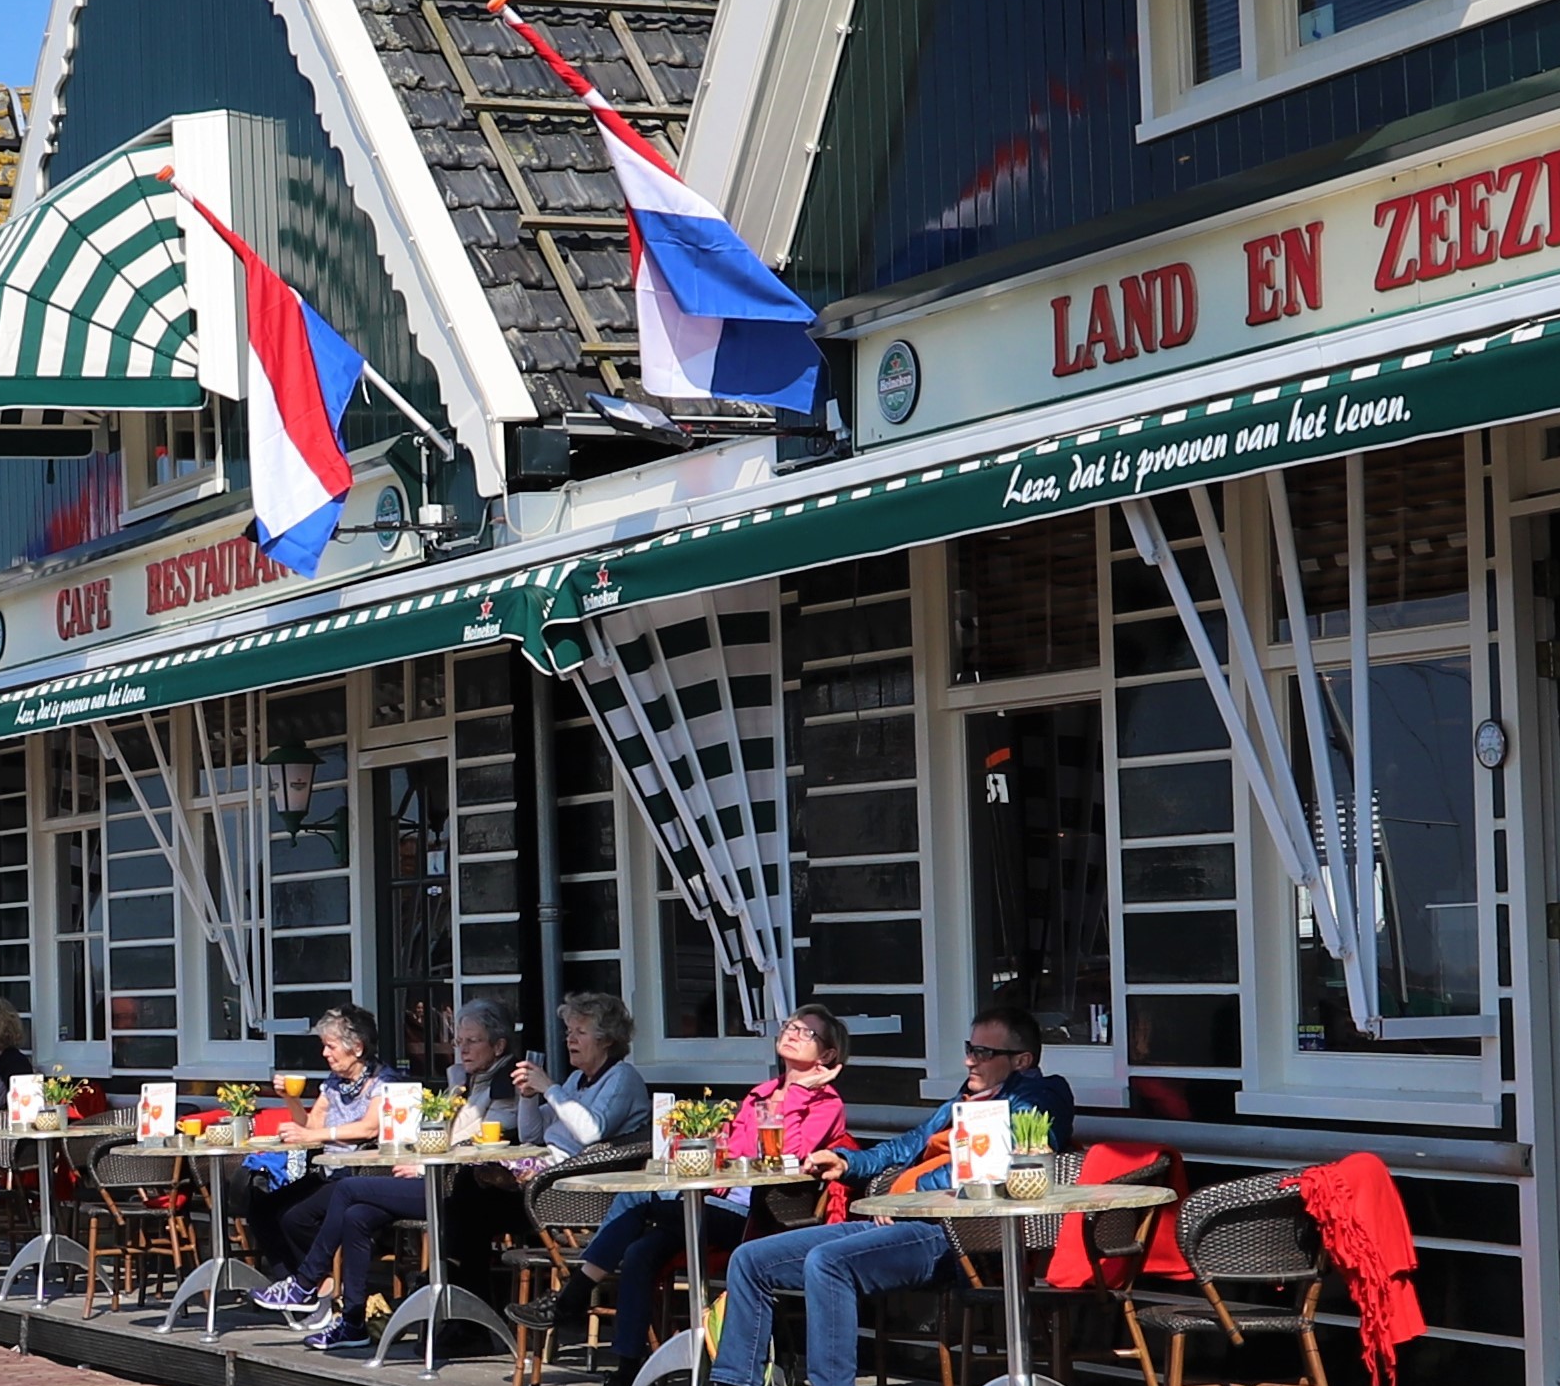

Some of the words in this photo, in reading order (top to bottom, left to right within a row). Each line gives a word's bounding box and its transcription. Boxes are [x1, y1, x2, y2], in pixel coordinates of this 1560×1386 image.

[1050, 261, 1198, 377] LAND
[1243, 220, 1325, 327] EN
[1002, 464, 1061, 509] Lezz,
[1068, 455, 1105, 492] dat
[1111, 450, 1131, 482] is
[1134, 433, 1228, 493] proeven
[1235, 420, 1279, 452] van
[1286, 398, 1327, 443] het
[1333, 394, 1411, 434] leven.
[56, 577, 111, 641] CAFE
[145, 535, 298, 615] RESTAURA
